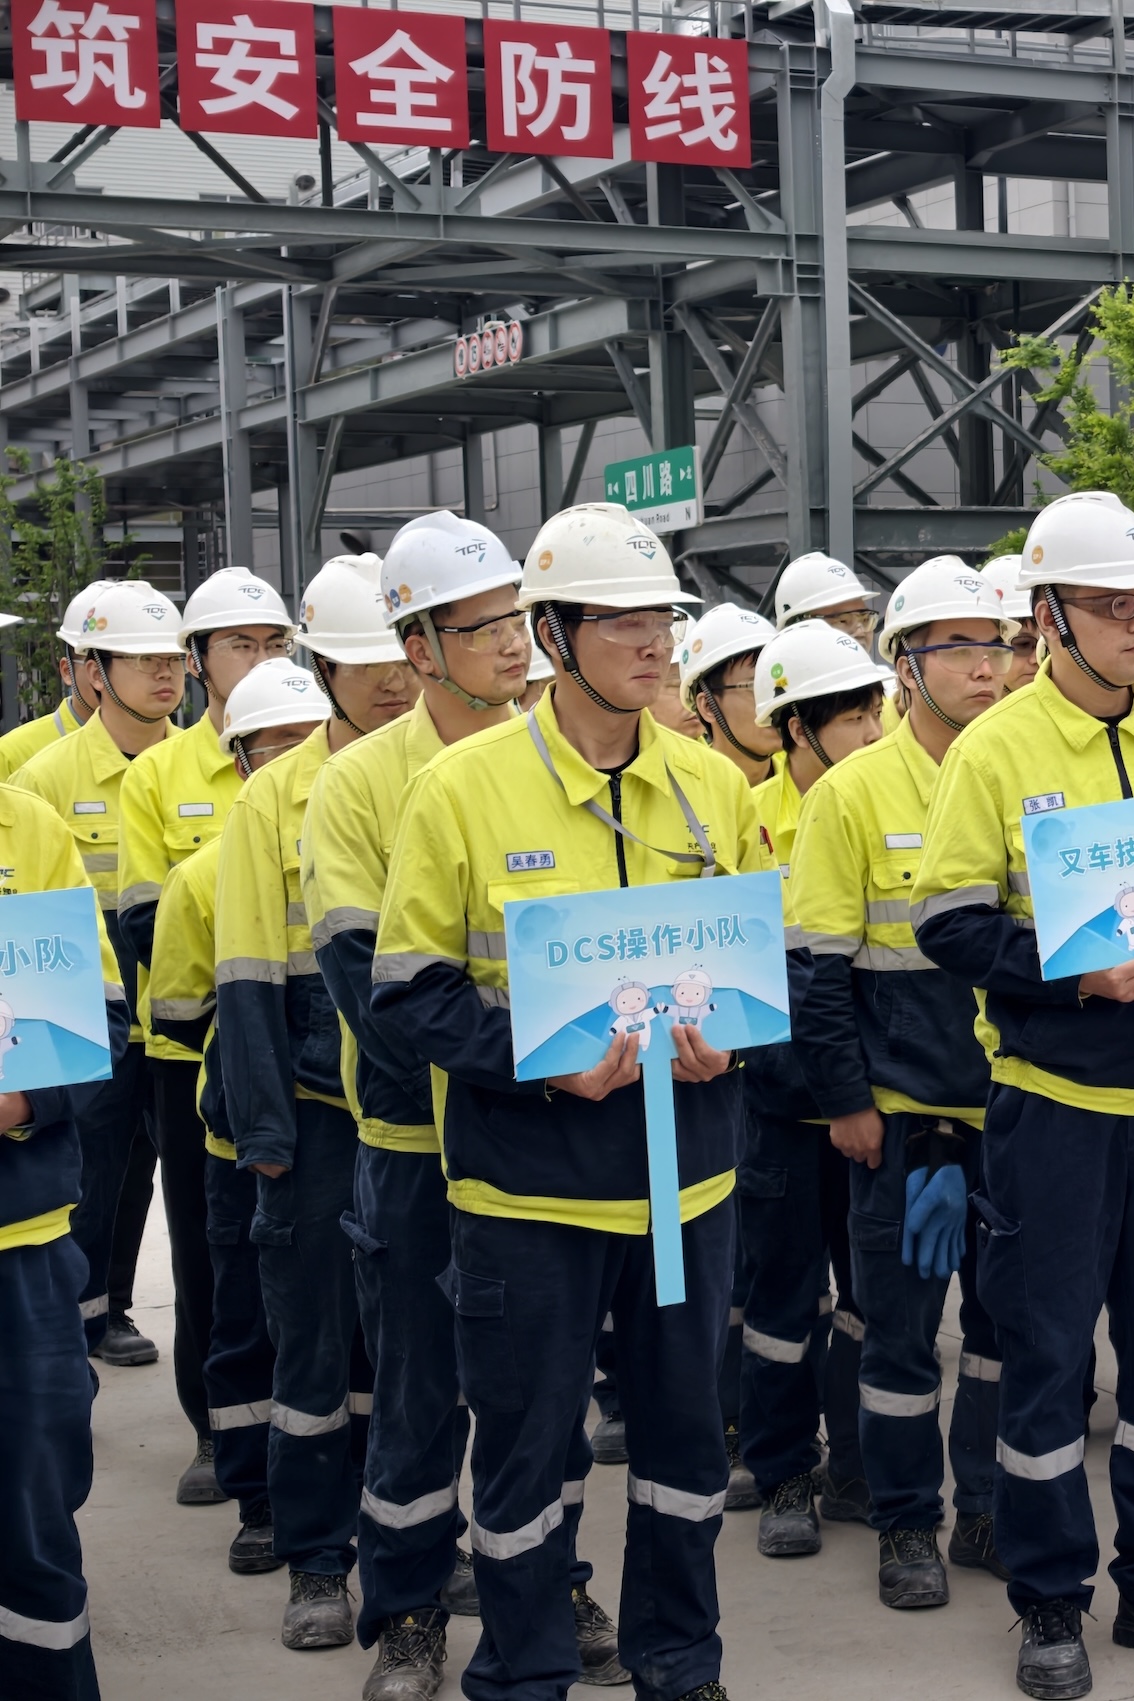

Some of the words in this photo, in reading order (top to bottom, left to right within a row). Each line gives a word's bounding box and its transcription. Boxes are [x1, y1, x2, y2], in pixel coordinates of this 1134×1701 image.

[27, 0, 738, 151] 筑安全防线
[624, 460, 673, 504] 四川路
[656, 512, 669, 523] Road
[685, 506, 691, 521] N
[511, 853, 551, 869] 吴春勇
[0, 934, 74, 977] 小队
[546, 914, 748, 968] DCS操作小队
